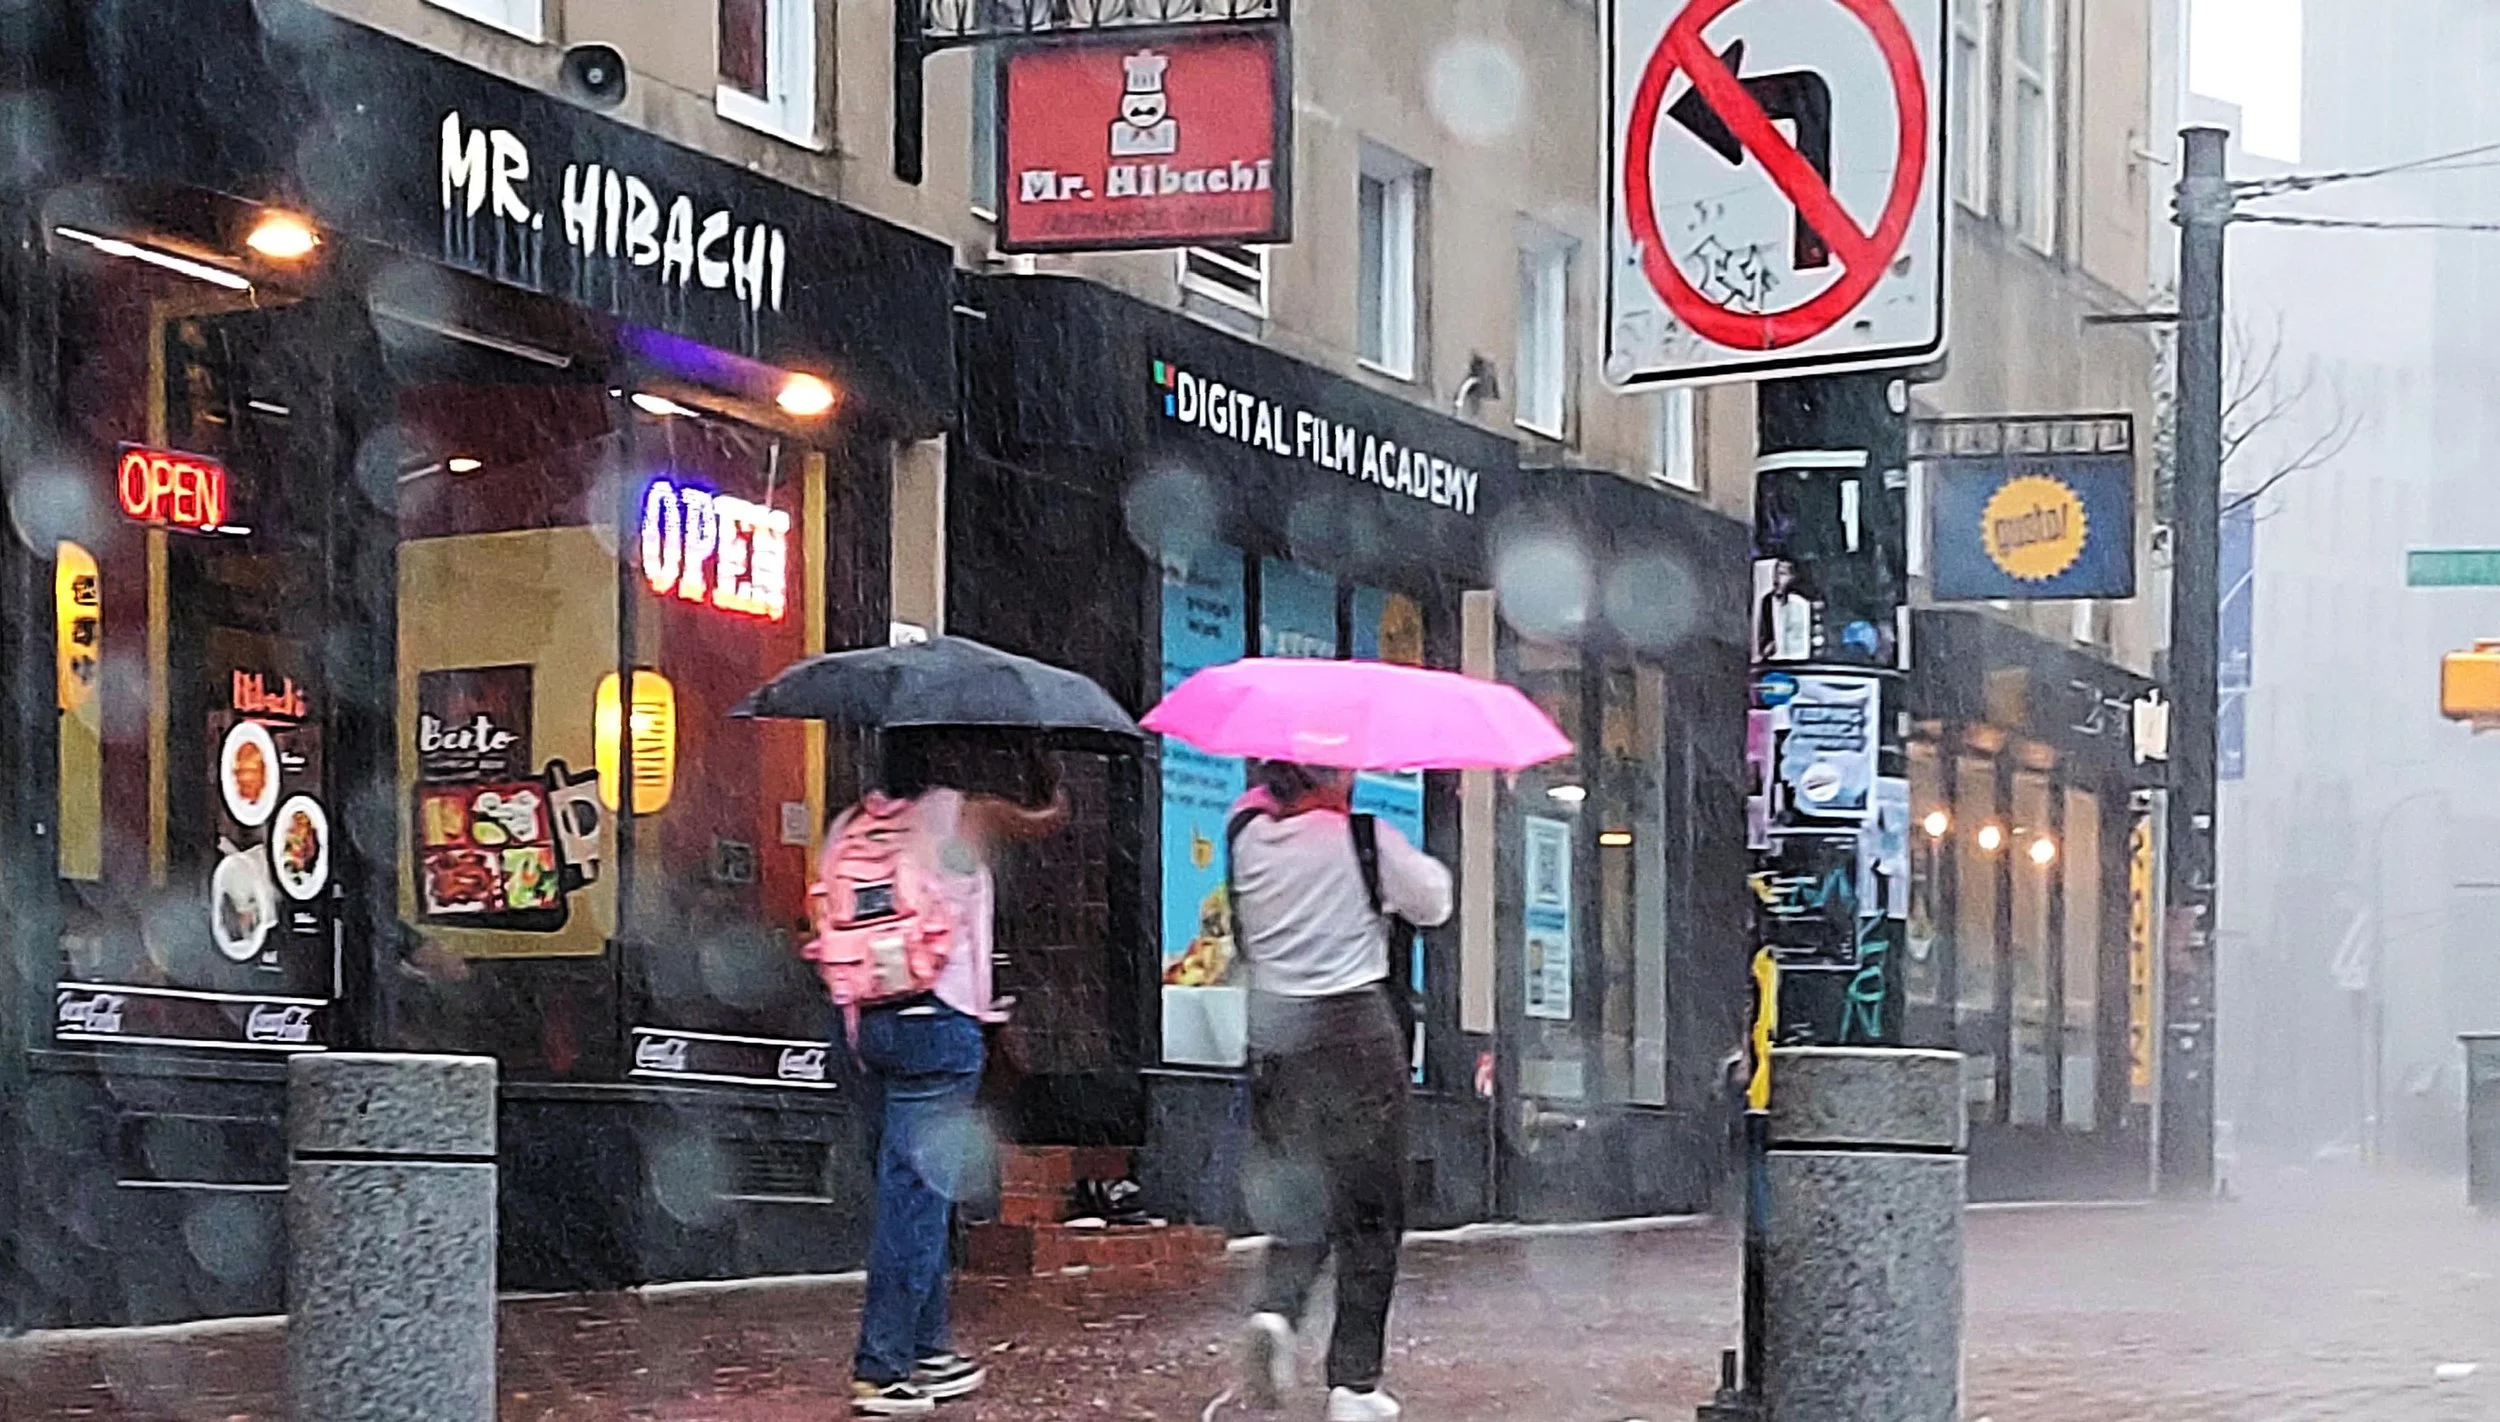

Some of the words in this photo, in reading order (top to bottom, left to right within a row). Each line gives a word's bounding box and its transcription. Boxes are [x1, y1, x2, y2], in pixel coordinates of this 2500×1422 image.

[442, 111, 544, 224] MR.
[562, 164, 786, 313] HIBACHI
[1020, 170, 1095, 202] Mr.
[1106, 159, 1273, 197] Hibachi
[122, 454, 221, 527] OPEN
[1178, 371, 1291, 456] DIGITAL
[1297, 411, 1356, 476] FILM
[1361, 435, 1478, 516] ACADEMY
[641, 480, 791, 622] OPEN
[420, 715, 520, 752] Bento
